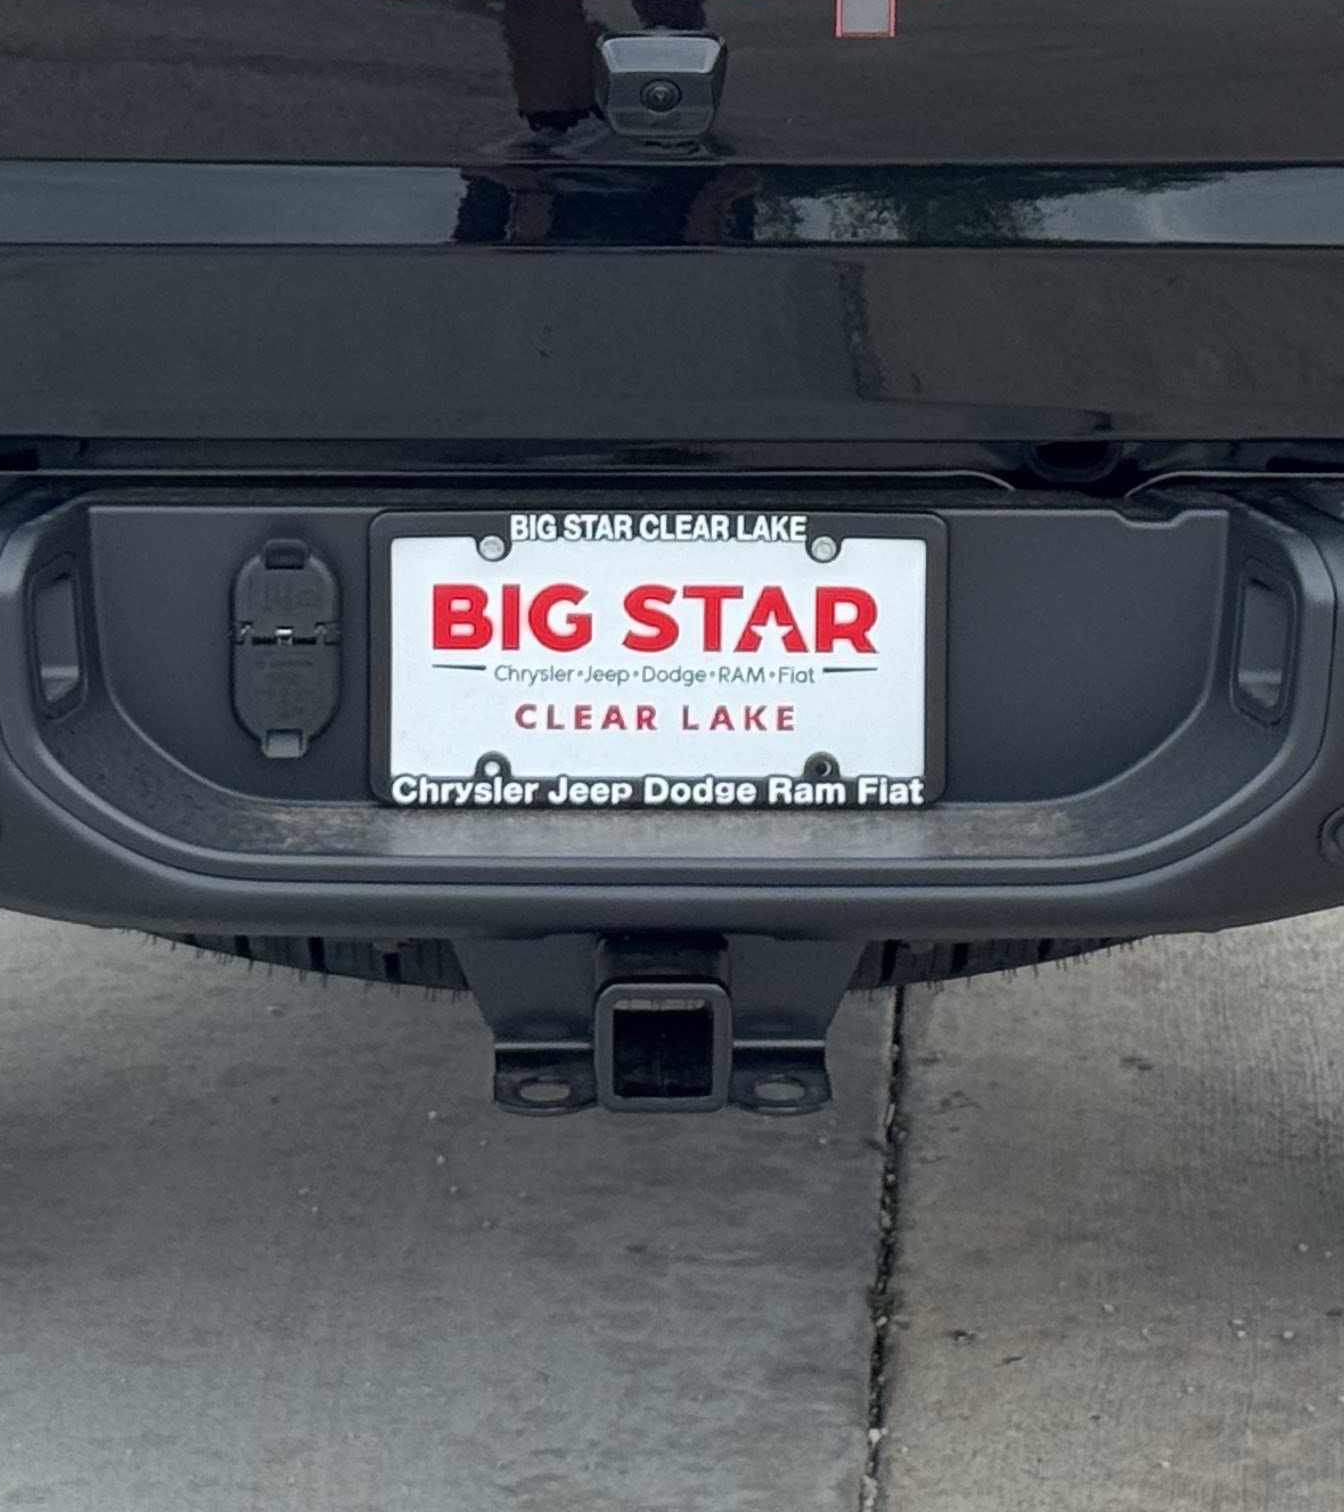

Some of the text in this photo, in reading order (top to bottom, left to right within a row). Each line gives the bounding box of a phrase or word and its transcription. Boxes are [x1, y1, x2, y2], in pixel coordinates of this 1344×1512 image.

[510, 514, 807, 541] BIG STAR CLEAR LAKE
[432, 583, 878, 653] BIG STAR
[494, 663, 815, 686] Chrysler Jeep Dodge RAM Fiat
[514, 703, 795, 731] CLEAR LAKE
[392, 776, 924, 807] Chrysler Jeep Dodge Ram Fiat
